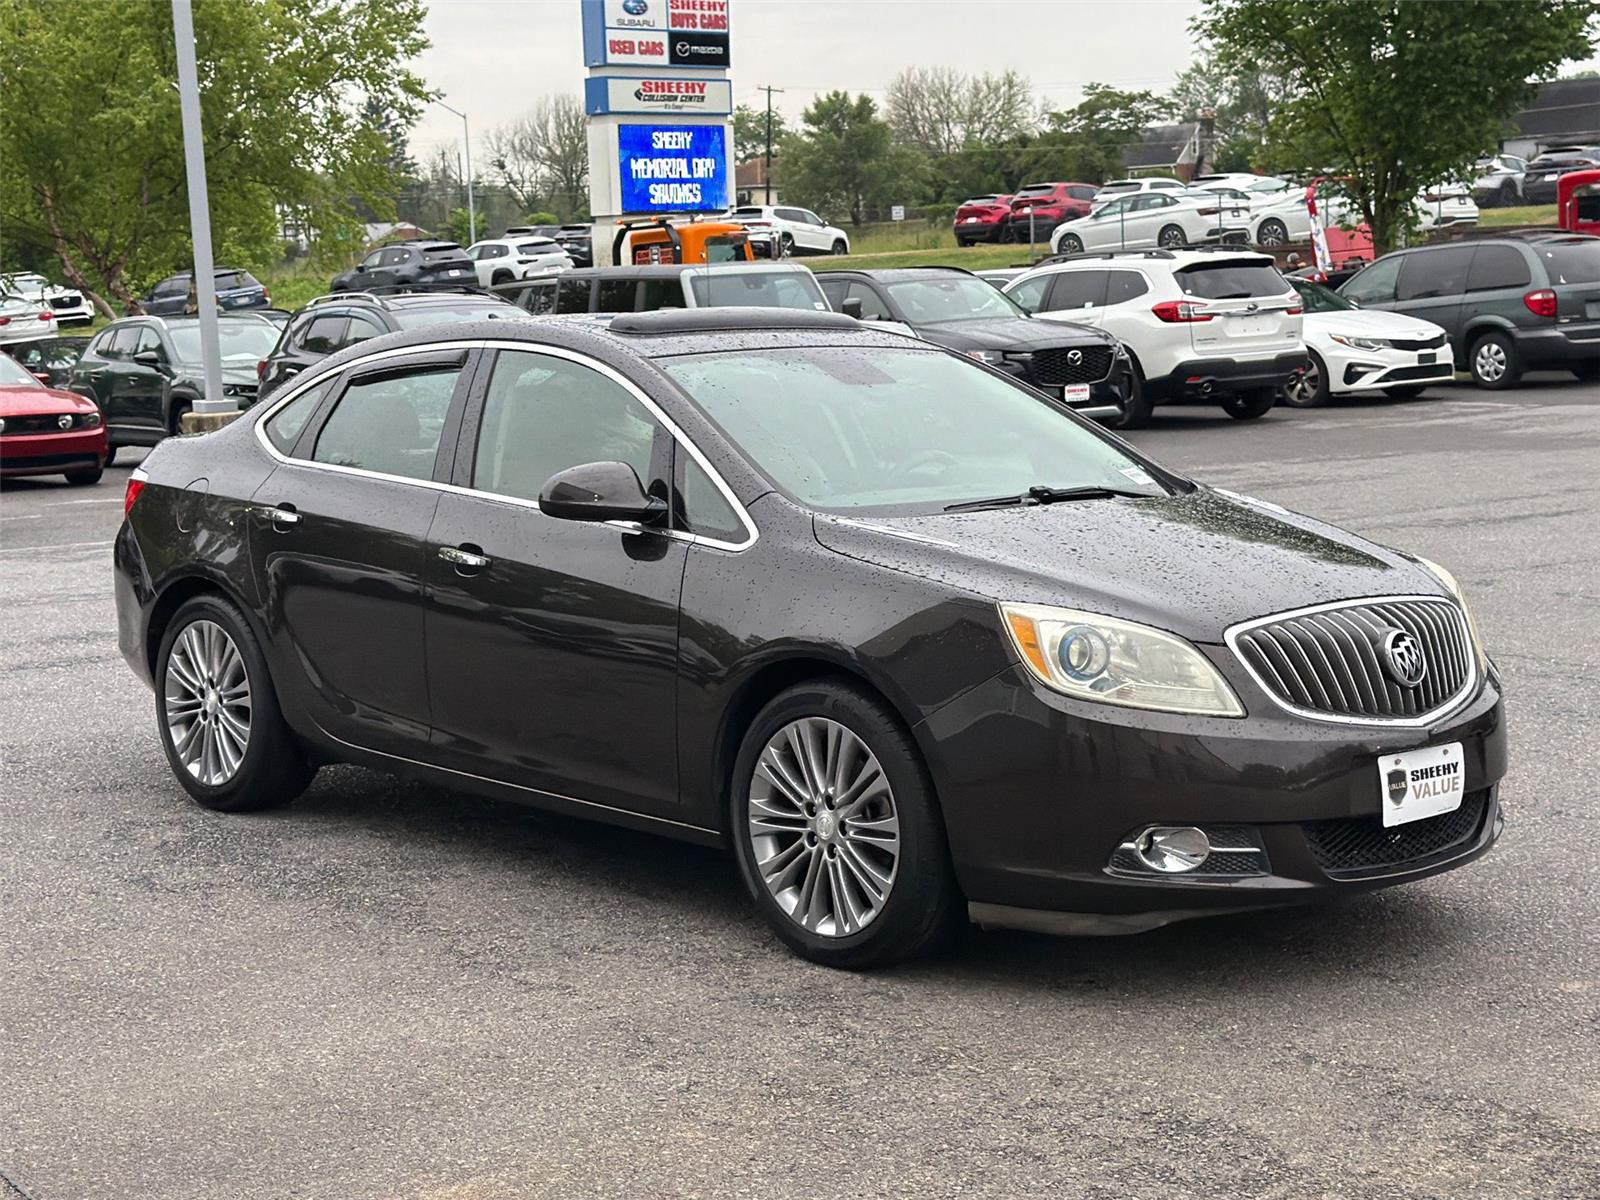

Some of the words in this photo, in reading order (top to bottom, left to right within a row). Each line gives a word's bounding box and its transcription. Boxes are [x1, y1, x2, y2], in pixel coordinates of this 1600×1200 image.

[669, 0, 727, 11] SHEEHY
[616, 18, 655, 27] SUBARU
[671, 12, 697, 28] BUYS
[700, 13, 727, 30] CARS
[609, 39, 635, 55] USED
[637, 40, 664, 56] CARS
[641, 81, 706, 94] SHEEHY
[642, 94, 678, 102] COLLISION
[679, 95, 706, 103] CENTER
[652, 131, 693, 149] SHEEHY
[630, 157, 691, 179] MEMORIAL
[692, 158, 715, 179] DAY
[649, 183, 702, 204] SAVINGS
[1411, 762, 1459, 781] SHEEHY
[1412, 776, 1460, 799] VALUE
